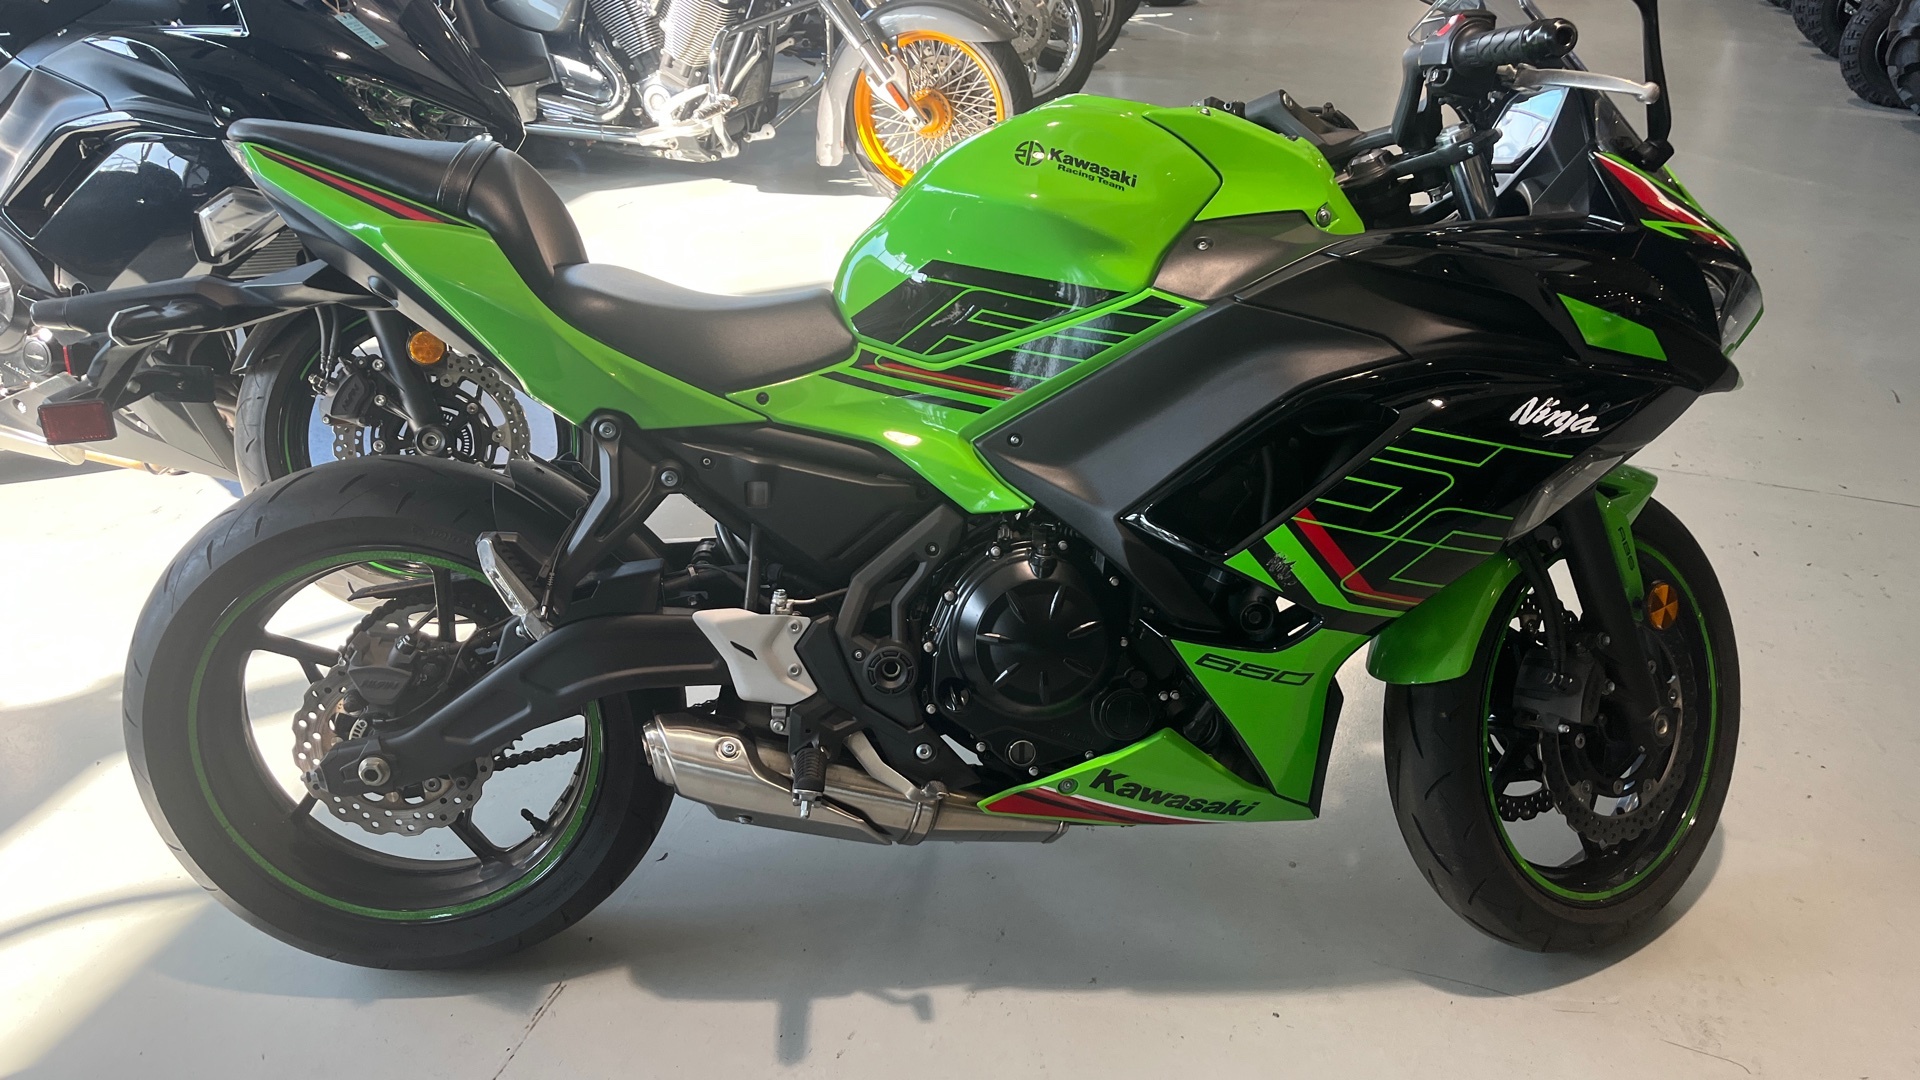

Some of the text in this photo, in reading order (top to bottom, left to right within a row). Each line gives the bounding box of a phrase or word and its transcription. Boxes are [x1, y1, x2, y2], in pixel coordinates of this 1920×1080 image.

[1049, 147, 1137, 188] Kawasaki
[1057, 164, 1125, 191] Racing Team
[1509, 396, 1599, 437] Ninja
[1617, 526, 1635, 571] ABS
[1194, 653, 1315, 686] 650
[1089, 768, 1260, 816] Kawasaki
